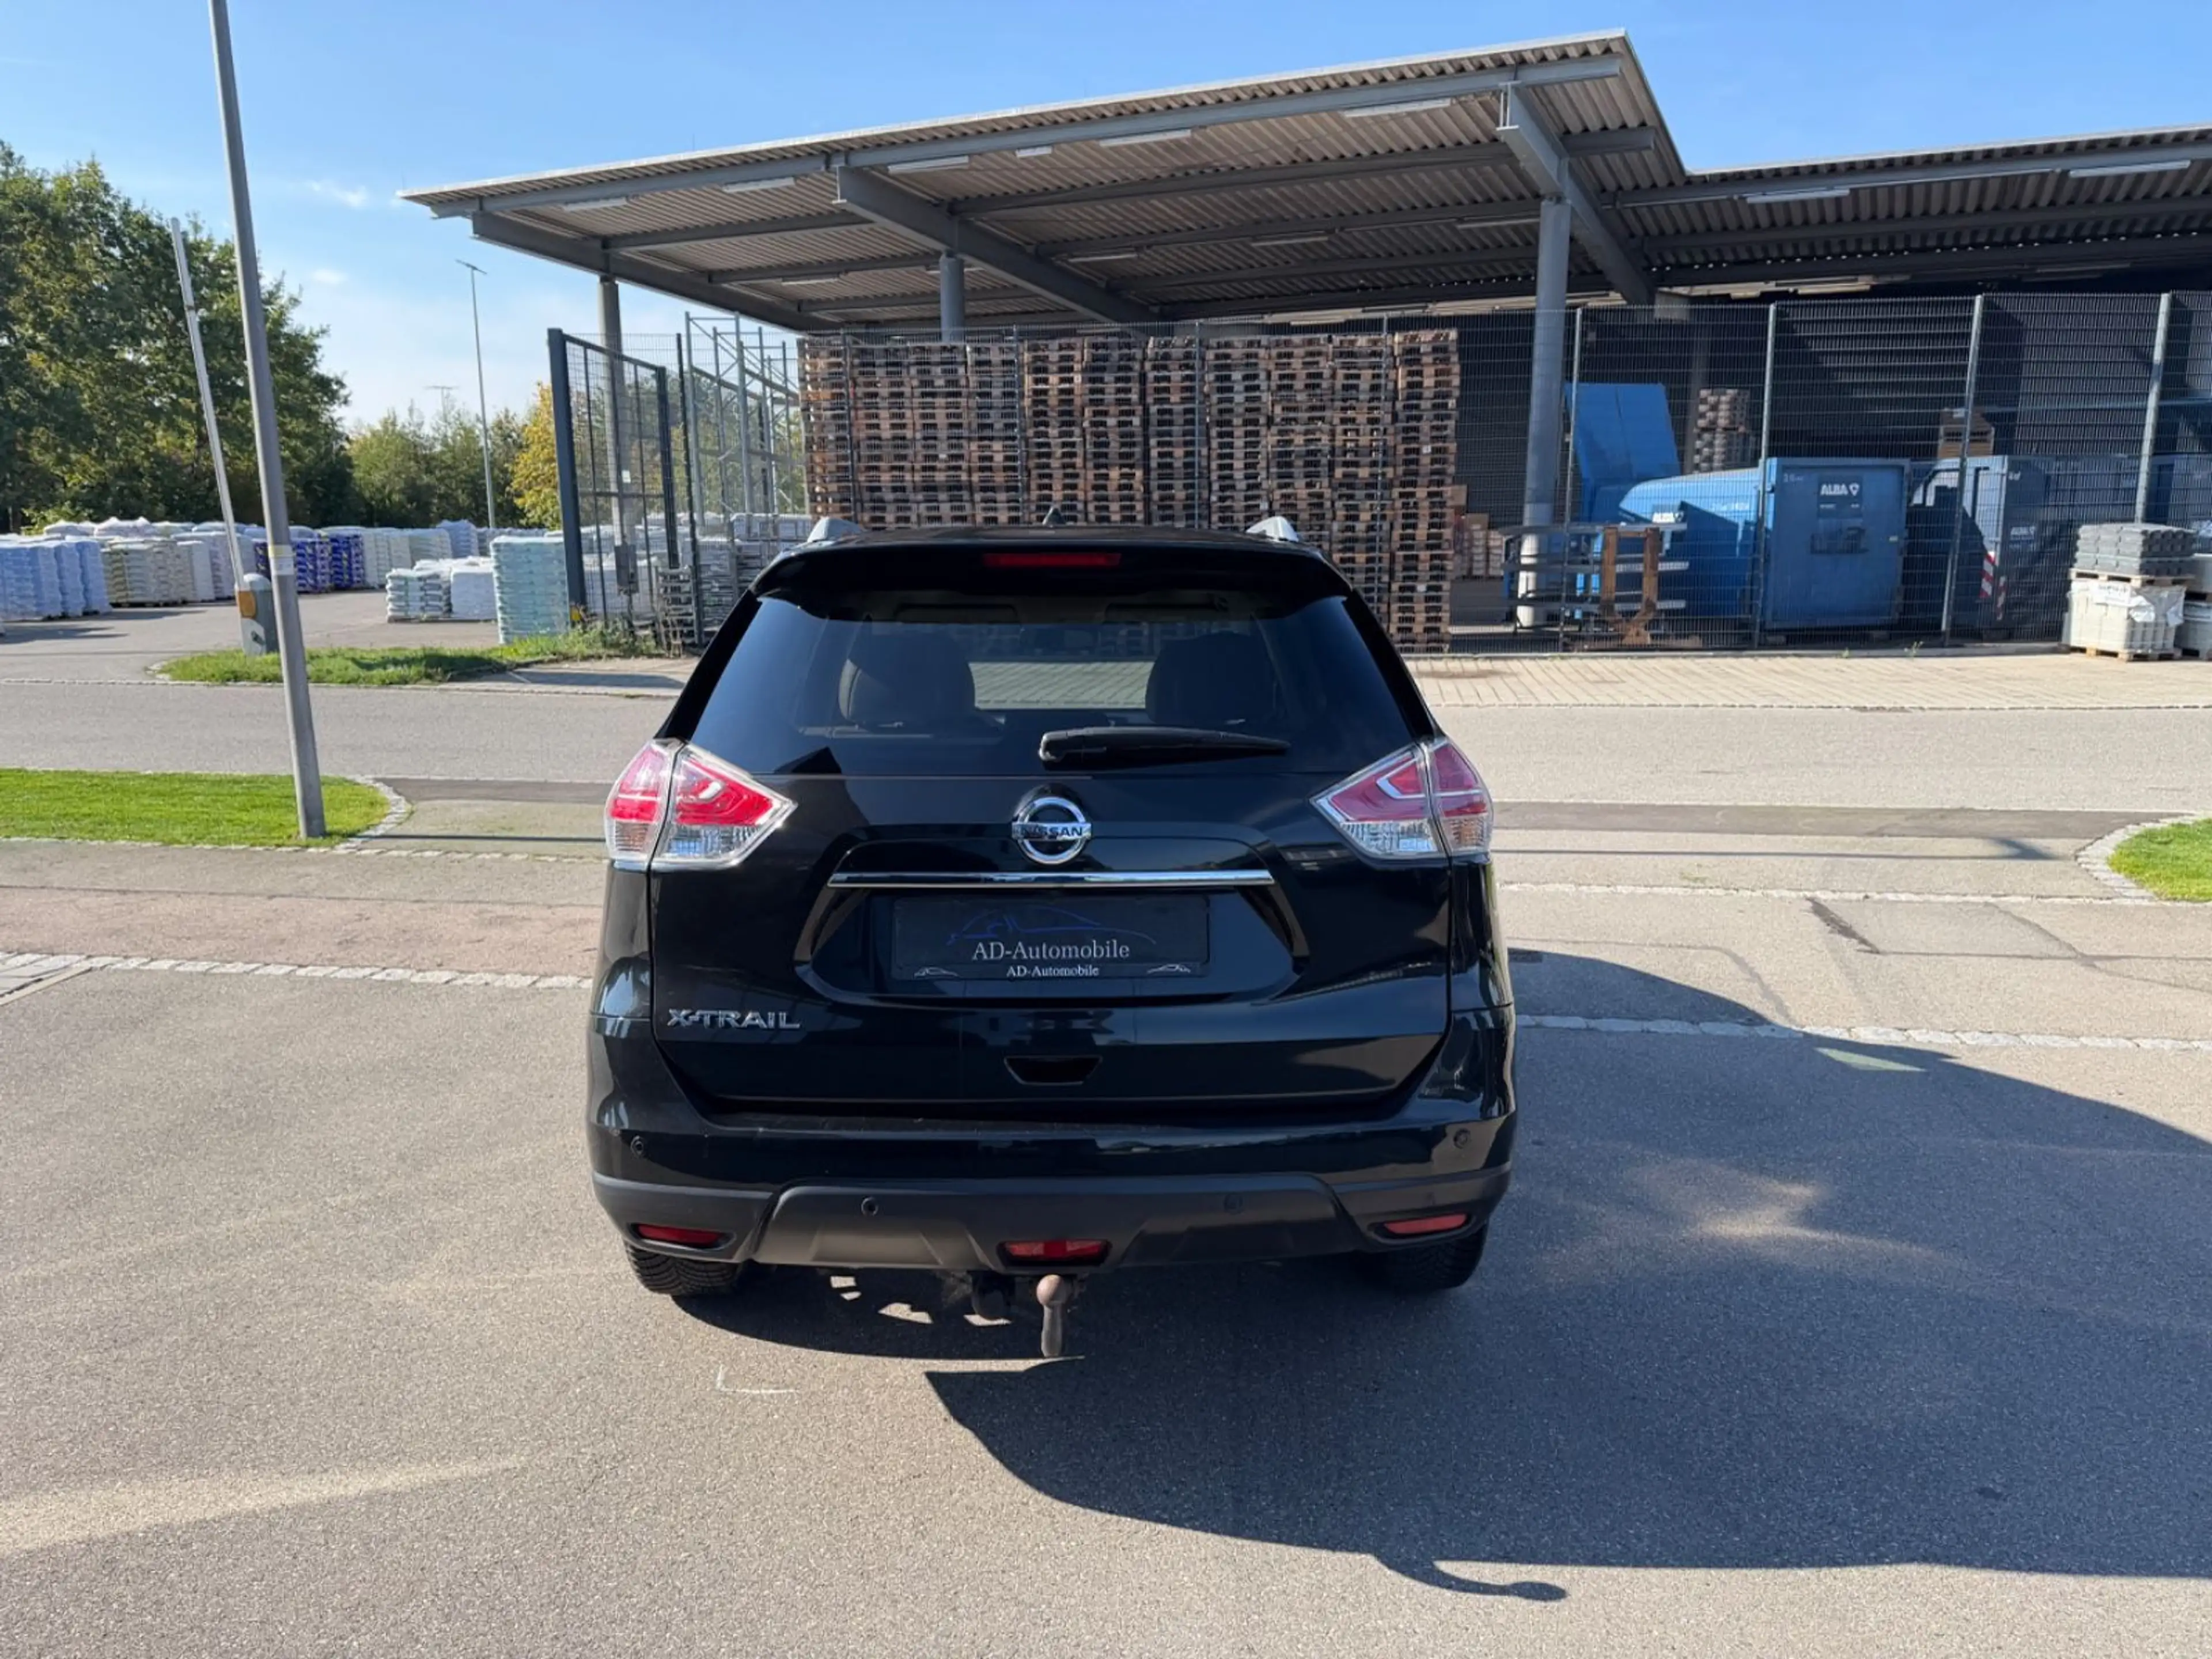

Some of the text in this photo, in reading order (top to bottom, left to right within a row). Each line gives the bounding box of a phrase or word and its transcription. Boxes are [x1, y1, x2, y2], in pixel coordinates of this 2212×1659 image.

[972, 940, 1130, 960] AD-Automobile
[1006, 964, 1099, 978] AD-Automobile
[667, 1009, 801, 1029] X-TRAIL
